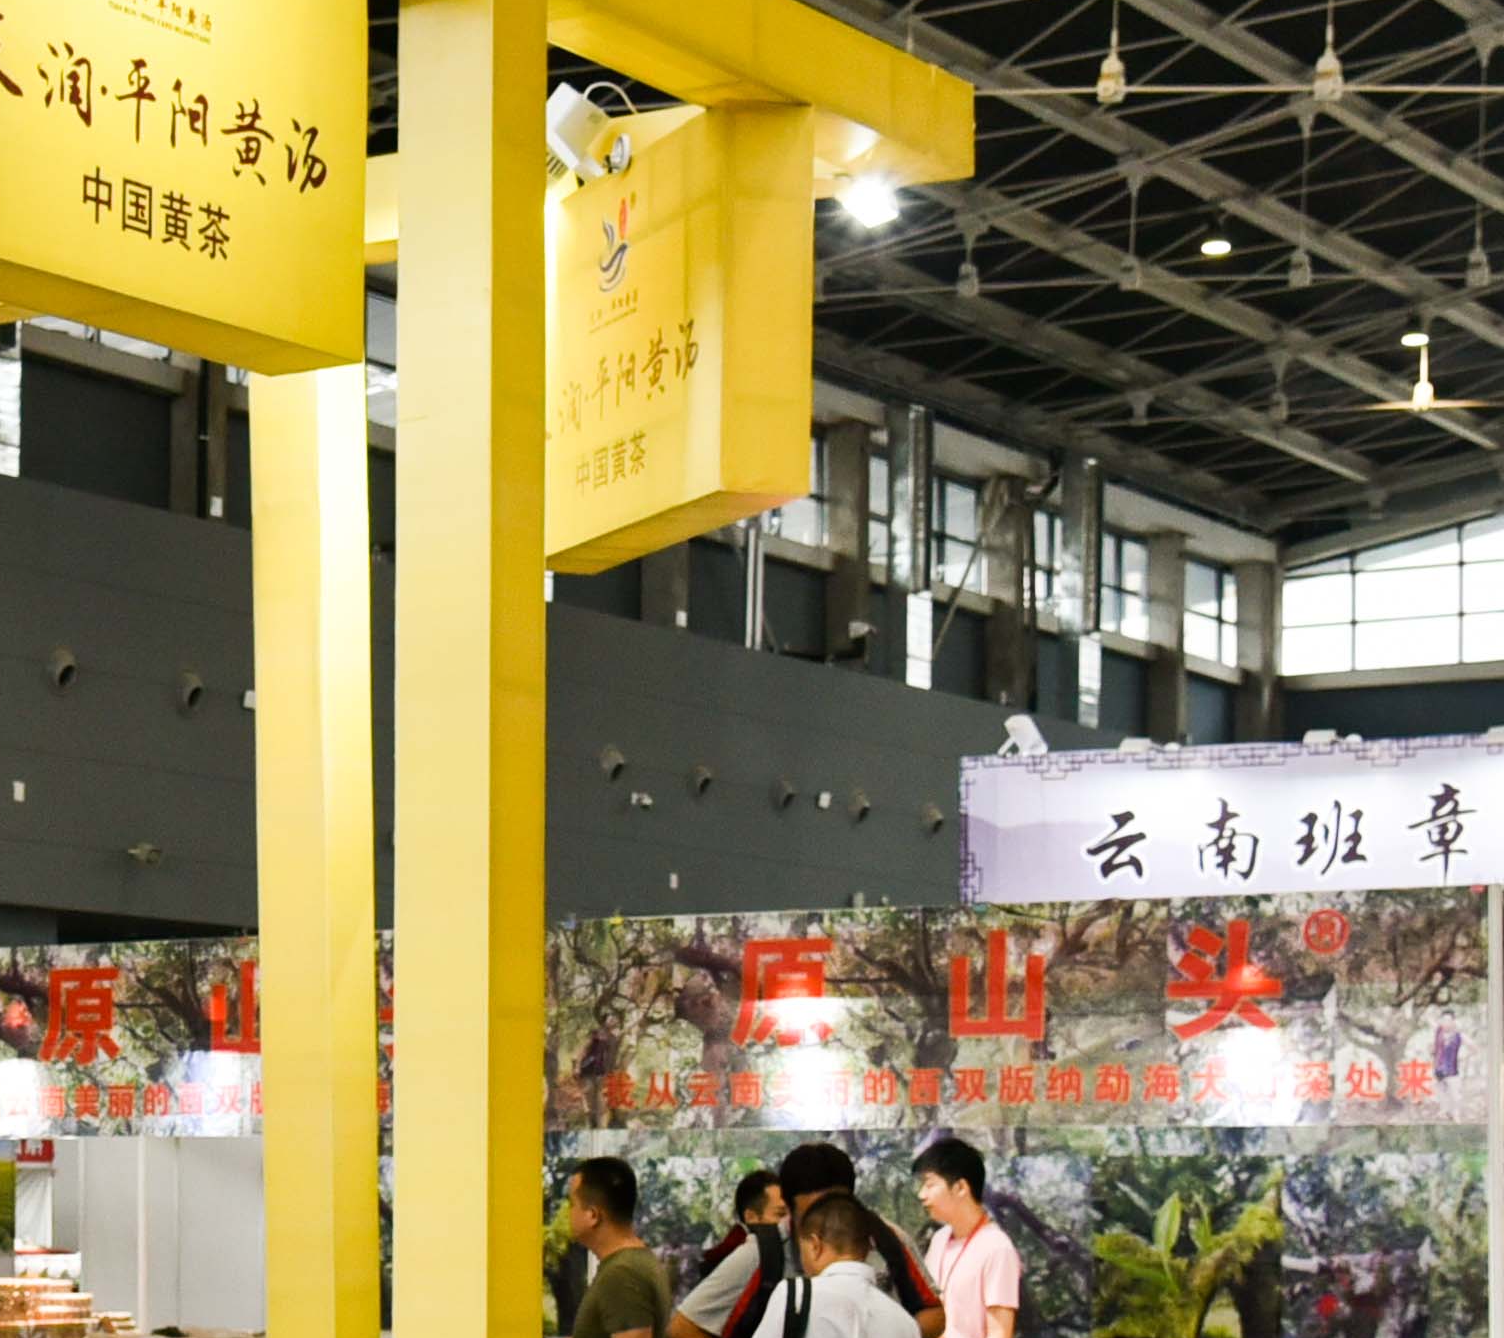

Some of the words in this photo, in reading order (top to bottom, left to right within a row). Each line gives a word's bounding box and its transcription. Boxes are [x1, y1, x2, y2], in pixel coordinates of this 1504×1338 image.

[82, 166, 231, 262] 中国黄茶
[575, 430, 648, 496] 中国黄茶
